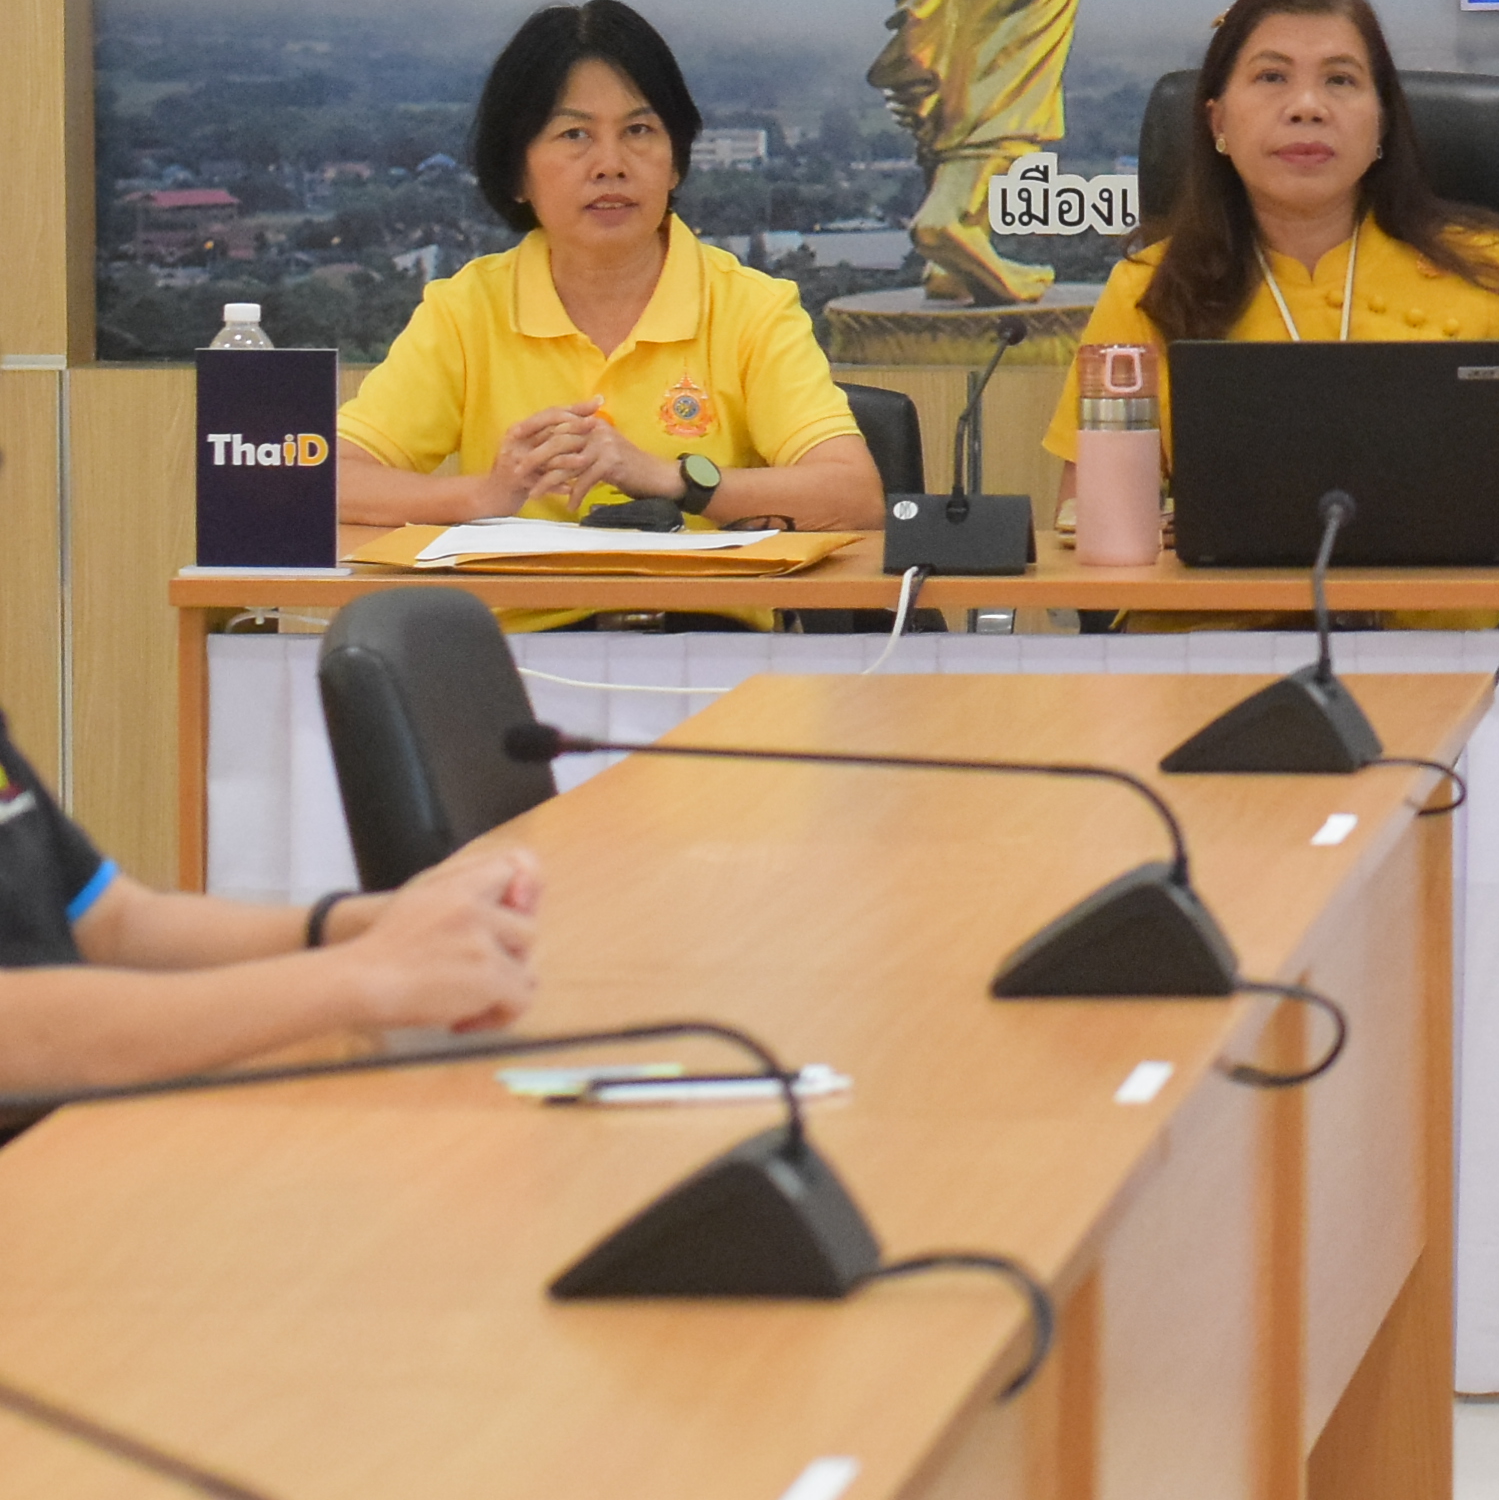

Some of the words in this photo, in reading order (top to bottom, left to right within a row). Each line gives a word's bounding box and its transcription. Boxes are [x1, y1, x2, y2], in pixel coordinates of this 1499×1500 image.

[1000, 164, 1136, 228] เมืองเ
[206, 433, 329, 467] ThaiD
